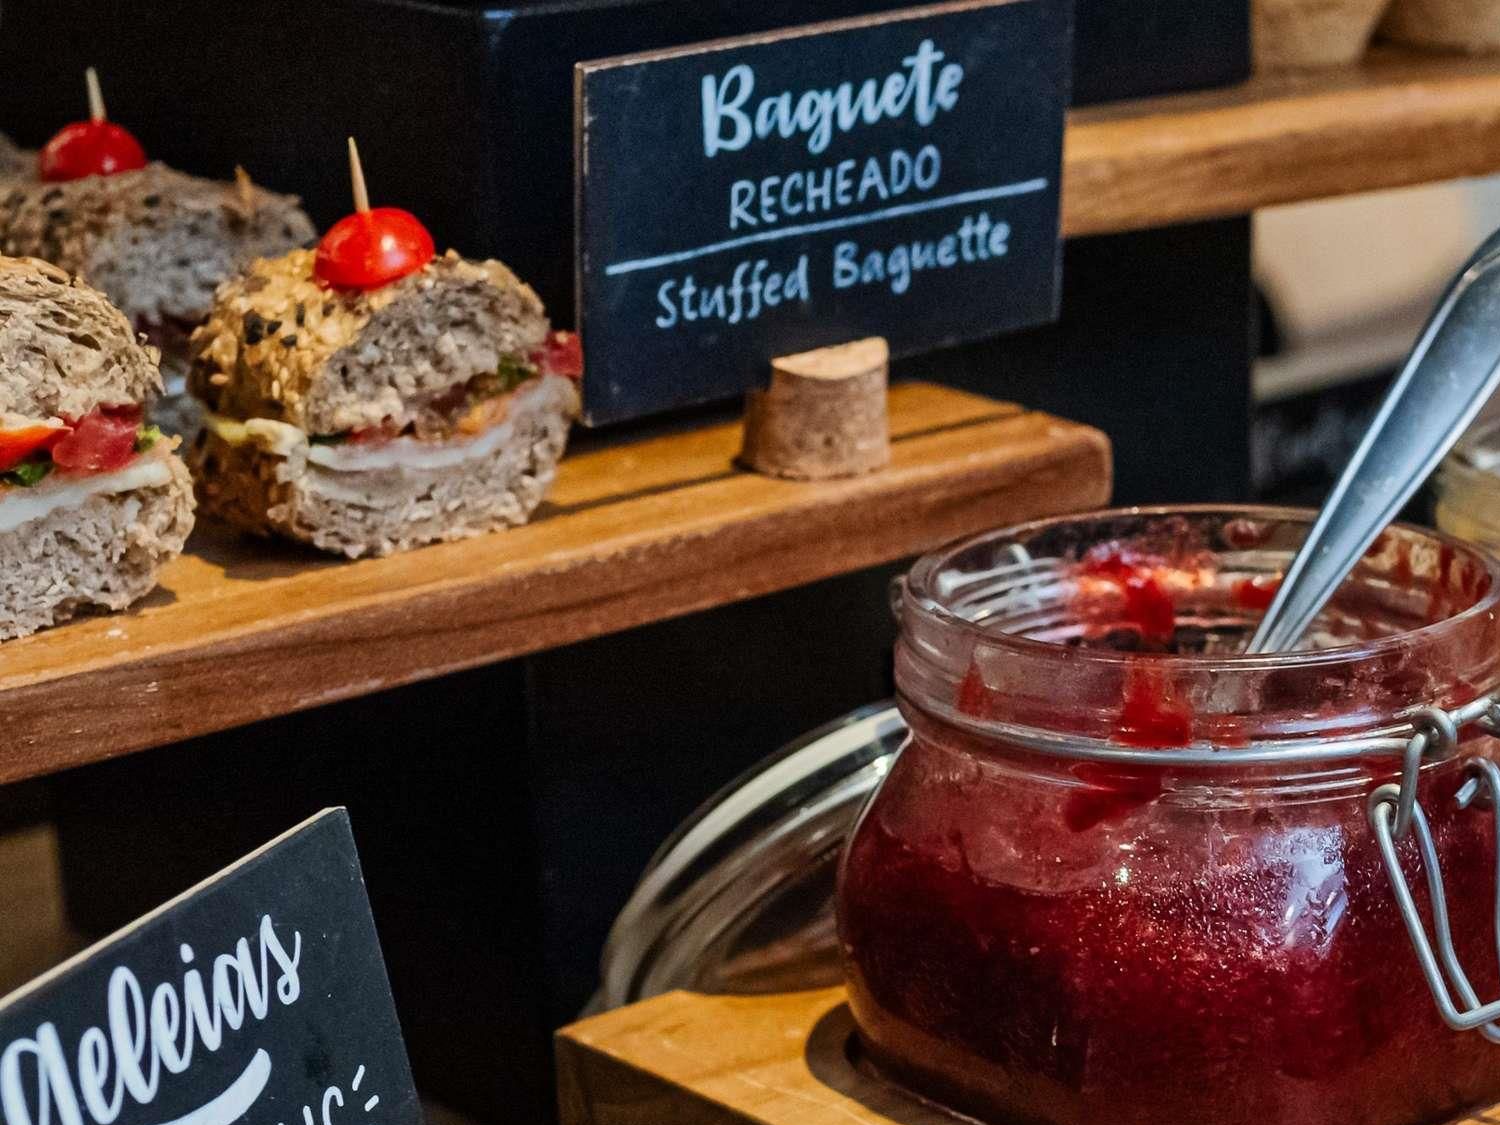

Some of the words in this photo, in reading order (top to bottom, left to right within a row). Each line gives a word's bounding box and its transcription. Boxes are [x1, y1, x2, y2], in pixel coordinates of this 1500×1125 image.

[701, 39, 964, 157] Baguete
[729, 145, 941, 229] RECHEADO
[656, 256, 809, 328] Stuffed
[833, 212, 1011, 294] Baguette
